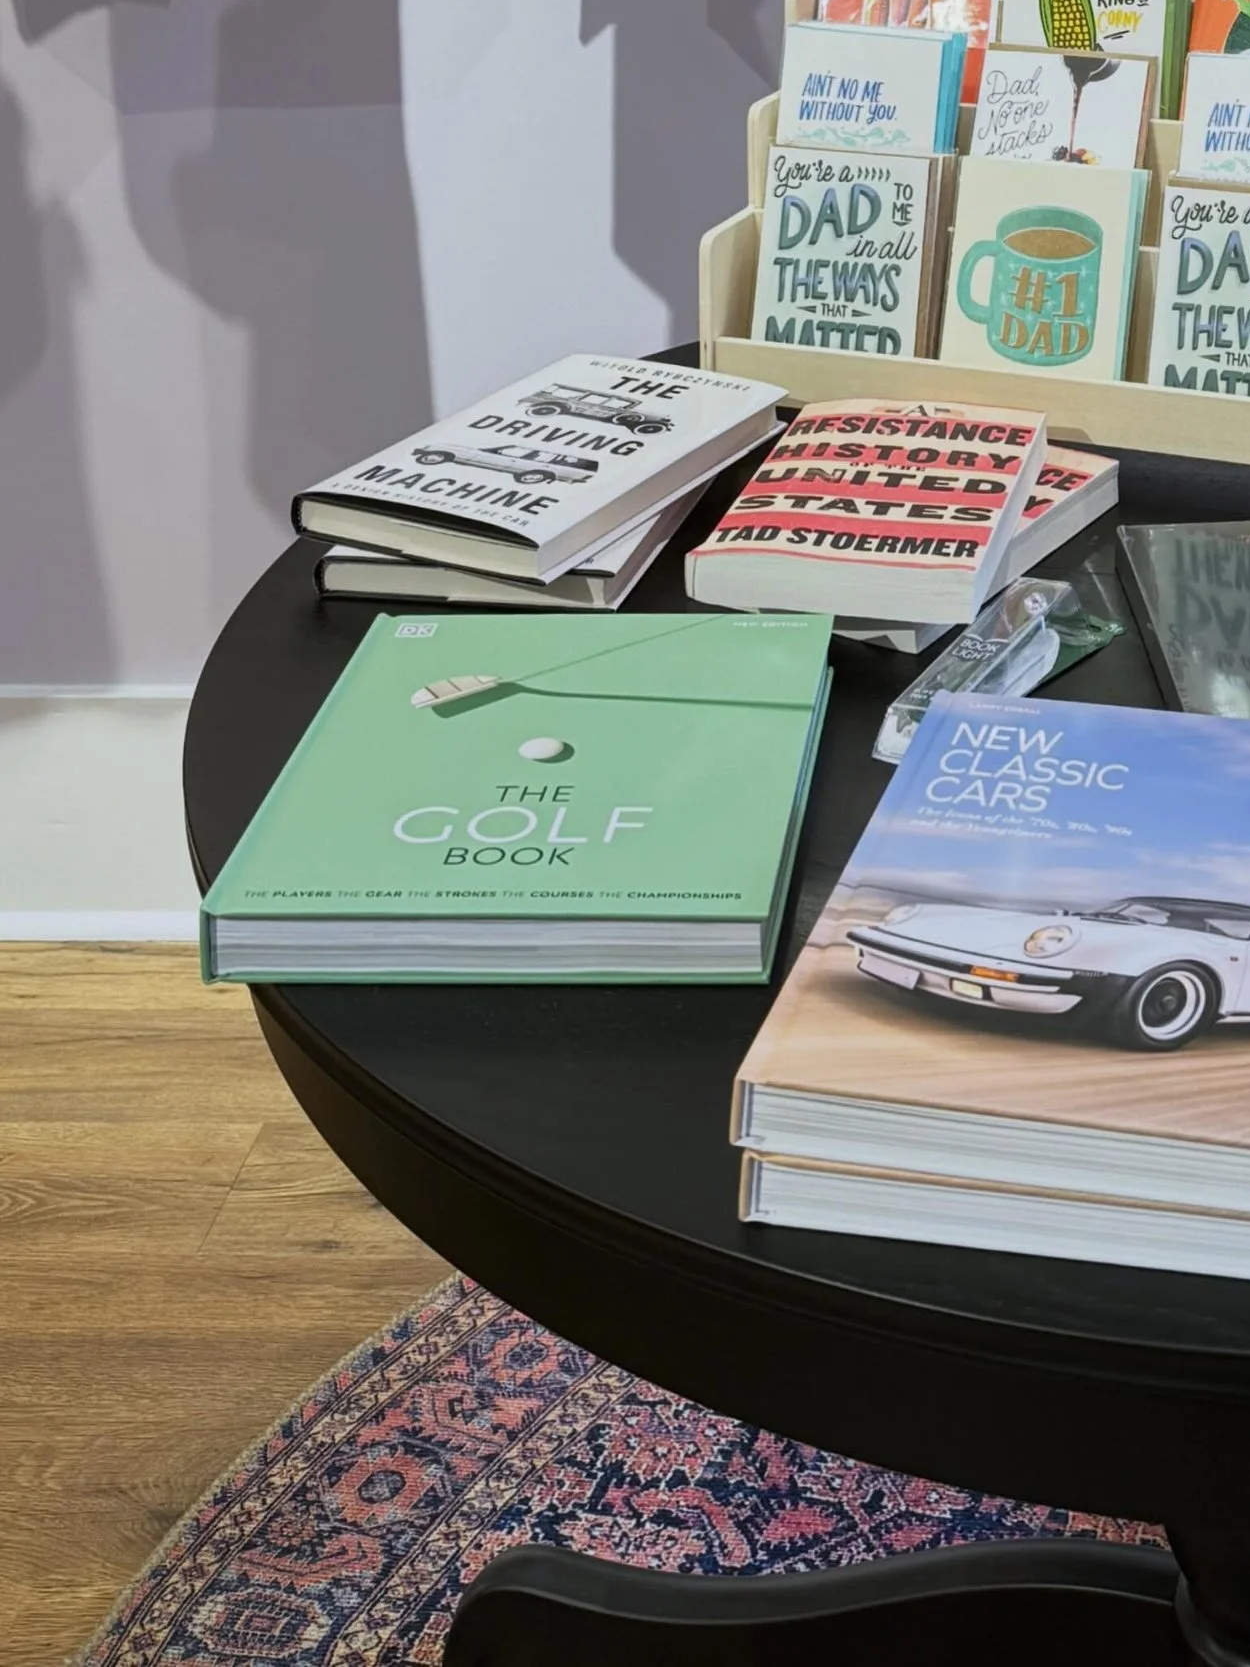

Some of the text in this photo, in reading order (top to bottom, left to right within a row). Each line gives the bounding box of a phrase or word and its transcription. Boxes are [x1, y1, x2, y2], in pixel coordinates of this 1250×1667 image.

[837, 77, 859, 100] NO
[861, 80, 885, 103] ME
[773, 155, 835, 198] You're
[777, 182, 913, 251] DAD TO
[891, 203, 914, 222] ME
[1170, 195, 1239, 240] You're
[846, 231, 918, 260] in all
[773, 257, 902, 313] THE WAYS
[1007, 265, 1085, 317] #1
[820, 303, 849, 318] THAT
[1171, 302, 1236, 351] THE
[999, 310, 1090, 357] DAD
[609, 376, 690, 400] THE
[467, 415, 645, 456] DRIVING
[788, 415, 1032, 447] RESISTANCE
[769, 442, 1021, 470] HISTORY
[353, 465, 561, 515] MACHINE
[754, 467, 1008, 495] UNITED
[734, 495, 994, 522] STATES
[715, 525, 980, 559] TAD STOERMER
[951, 647, 994, 660] LIGHT
[959, 638, 1001, 652] BOOK
[951, 722, 1064, 755] NEW
[939, 748, 1129, 791] CLASSIC
[495, 785, 575, 803] THE
[926, 776, 1051, 812] CARS
[393, 805, 654, 845] GOLF
[442, 846, 575, 867] BOOK
[272, 890, 332, 898] PLAYERS
[365, 890, 403, 898] GEAR
[435, 890, 497, 898] STROKES
[529, 890, 594, 898] COURSES
[627, 890, 742, 900] CHAMPIONSHIPS
